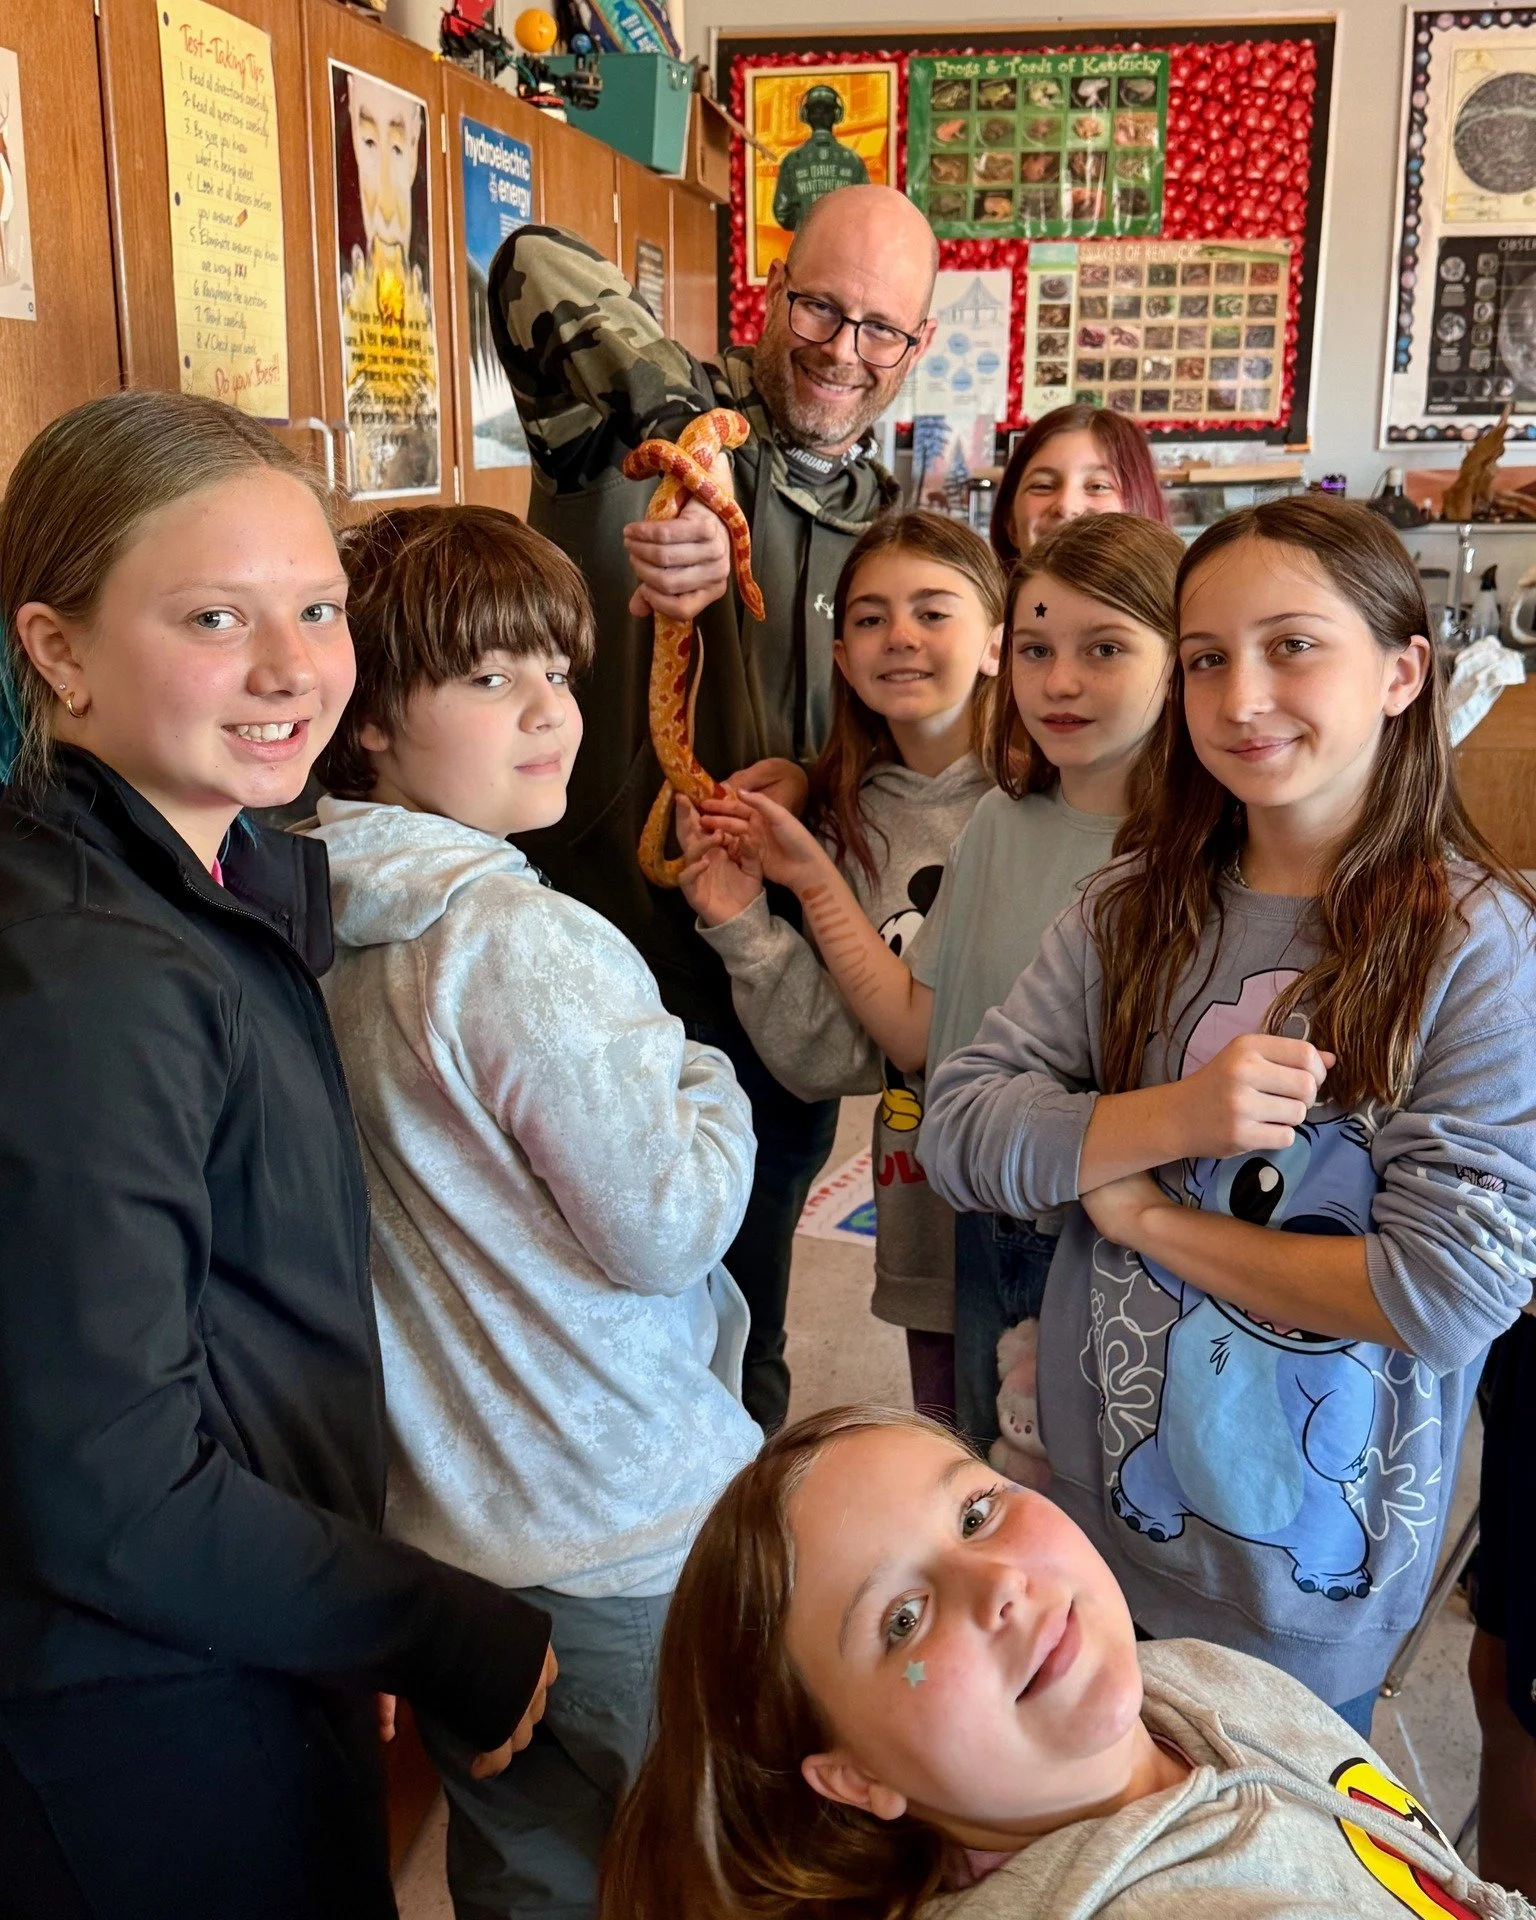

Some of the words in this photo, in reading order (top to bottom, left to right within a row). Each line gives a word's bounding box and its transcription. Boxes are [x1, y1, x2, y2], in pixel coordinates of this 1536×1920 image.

[180, 24, 245, 90] Test-Taking
[246, 53, 264, 91] Tips
[934, 61, 981, 79] Frogs
[985, 59, 1000, 75] &
[1004, 56, 1052, 76] Toads
[1058, 57, 1076, 74] of
[464, 126, 531, 181] hydroelectric
[498, 179, 531, 217] energy
[215, 367, 230, 397] Do
[232, 370, 253, 406] your
[786, 447, 833, 474] JAGUARS
